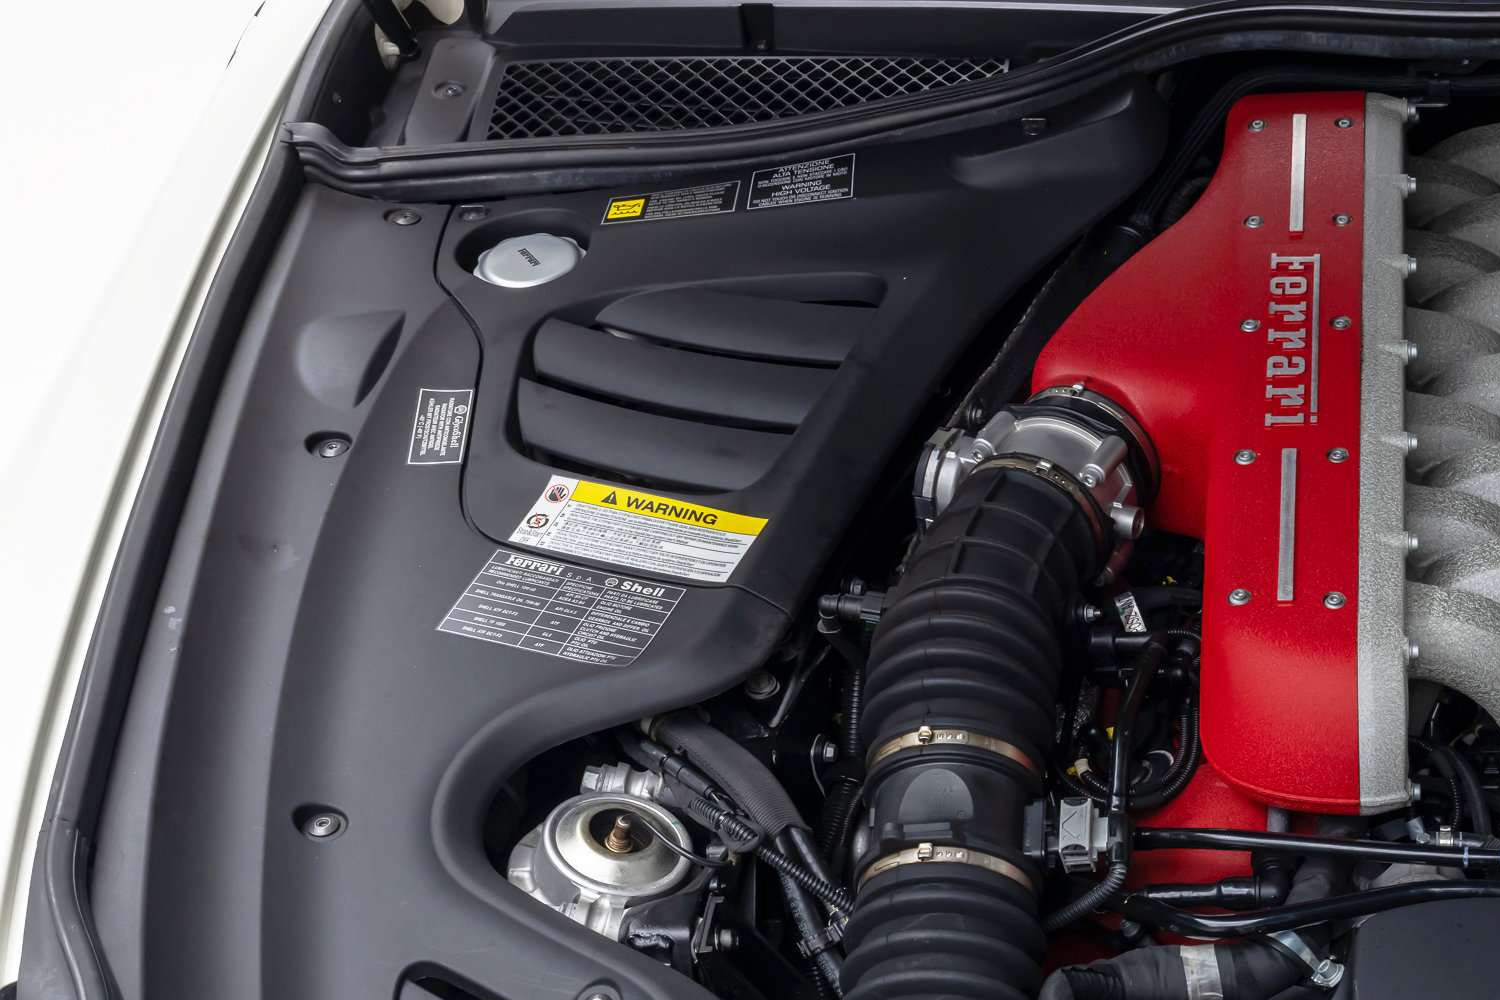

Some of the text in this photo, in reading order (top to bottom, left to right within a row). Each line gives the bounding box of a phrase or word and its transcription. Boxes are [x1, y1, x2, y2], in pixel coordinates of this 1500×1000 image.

[779, 159, 829, 172] ATTENZIONE
[794, 164, 834, 174] TENSIONE
[782, 180, 821, 190] WARNING
[795, 184, 830, 193] VOLTAGE
[518, 248, 540, 266] Ferrari
[1264, 252, 1320, 426] Ferrari
[450, 416, 463, 447] GlycoShell
[626, 496, 719, 526] WARNING
[505, 554, 566, 576] Ferrari
[620, 580, 666, 598] Shell
[610, 634, 637, 642] HYDRAULIC
